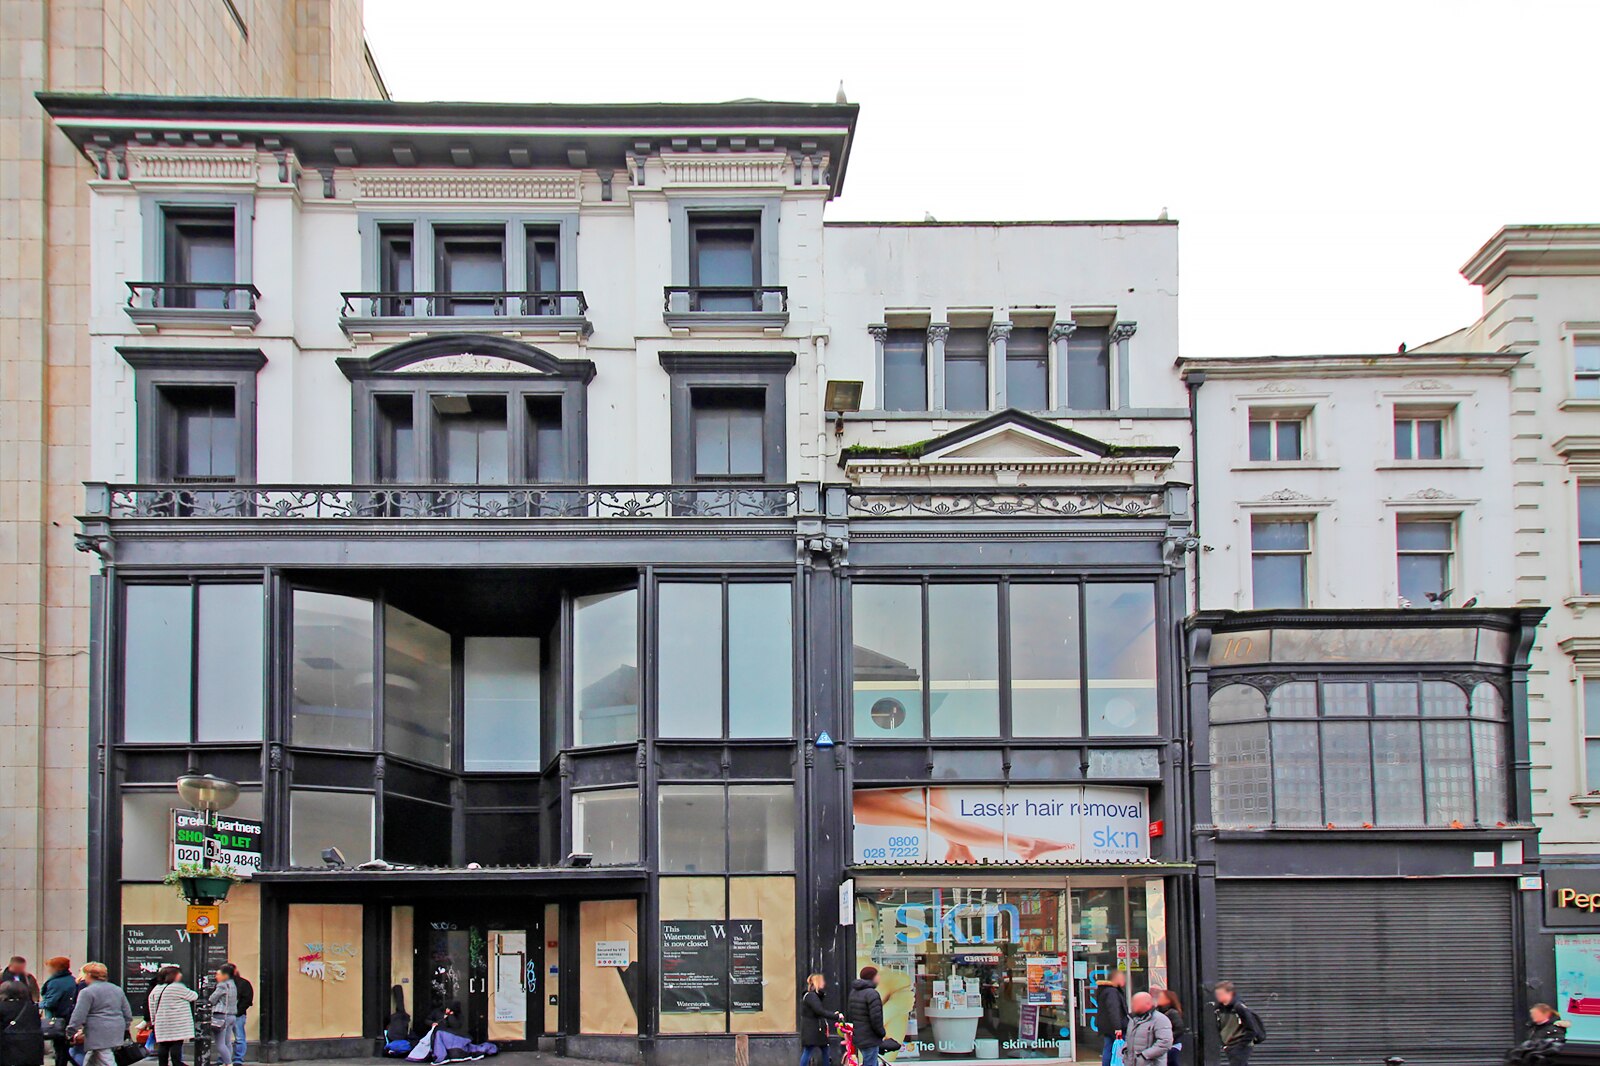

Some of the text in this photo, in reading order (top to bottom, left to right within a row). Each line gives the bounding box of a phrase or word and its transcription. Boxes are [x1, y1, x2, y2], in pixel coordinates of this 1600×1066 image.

[960, 799, 1142, 819] Laser hair removal
[217, 820, 262, 835] partners
[177, 829, 203, 843] SHO
[231, 836, 252, 849] LET
[888, 836, 919, 847] 0800
[1092, 825, 1139, 849] sk:n
[177, 848, 200, 862] 020
[233, 854, 261, 868] 4848
[863, 847, 919, 859] 028 7222
[663, 925, 680, 933] This
[740, 924, 753, 934] W
[127, 937, 171, 945] Waterstones
[663, 933, 706, 941] Waterstones
[911, 1040, 935, 1051] The
[1002, 1038, 1028, 1050] skin
